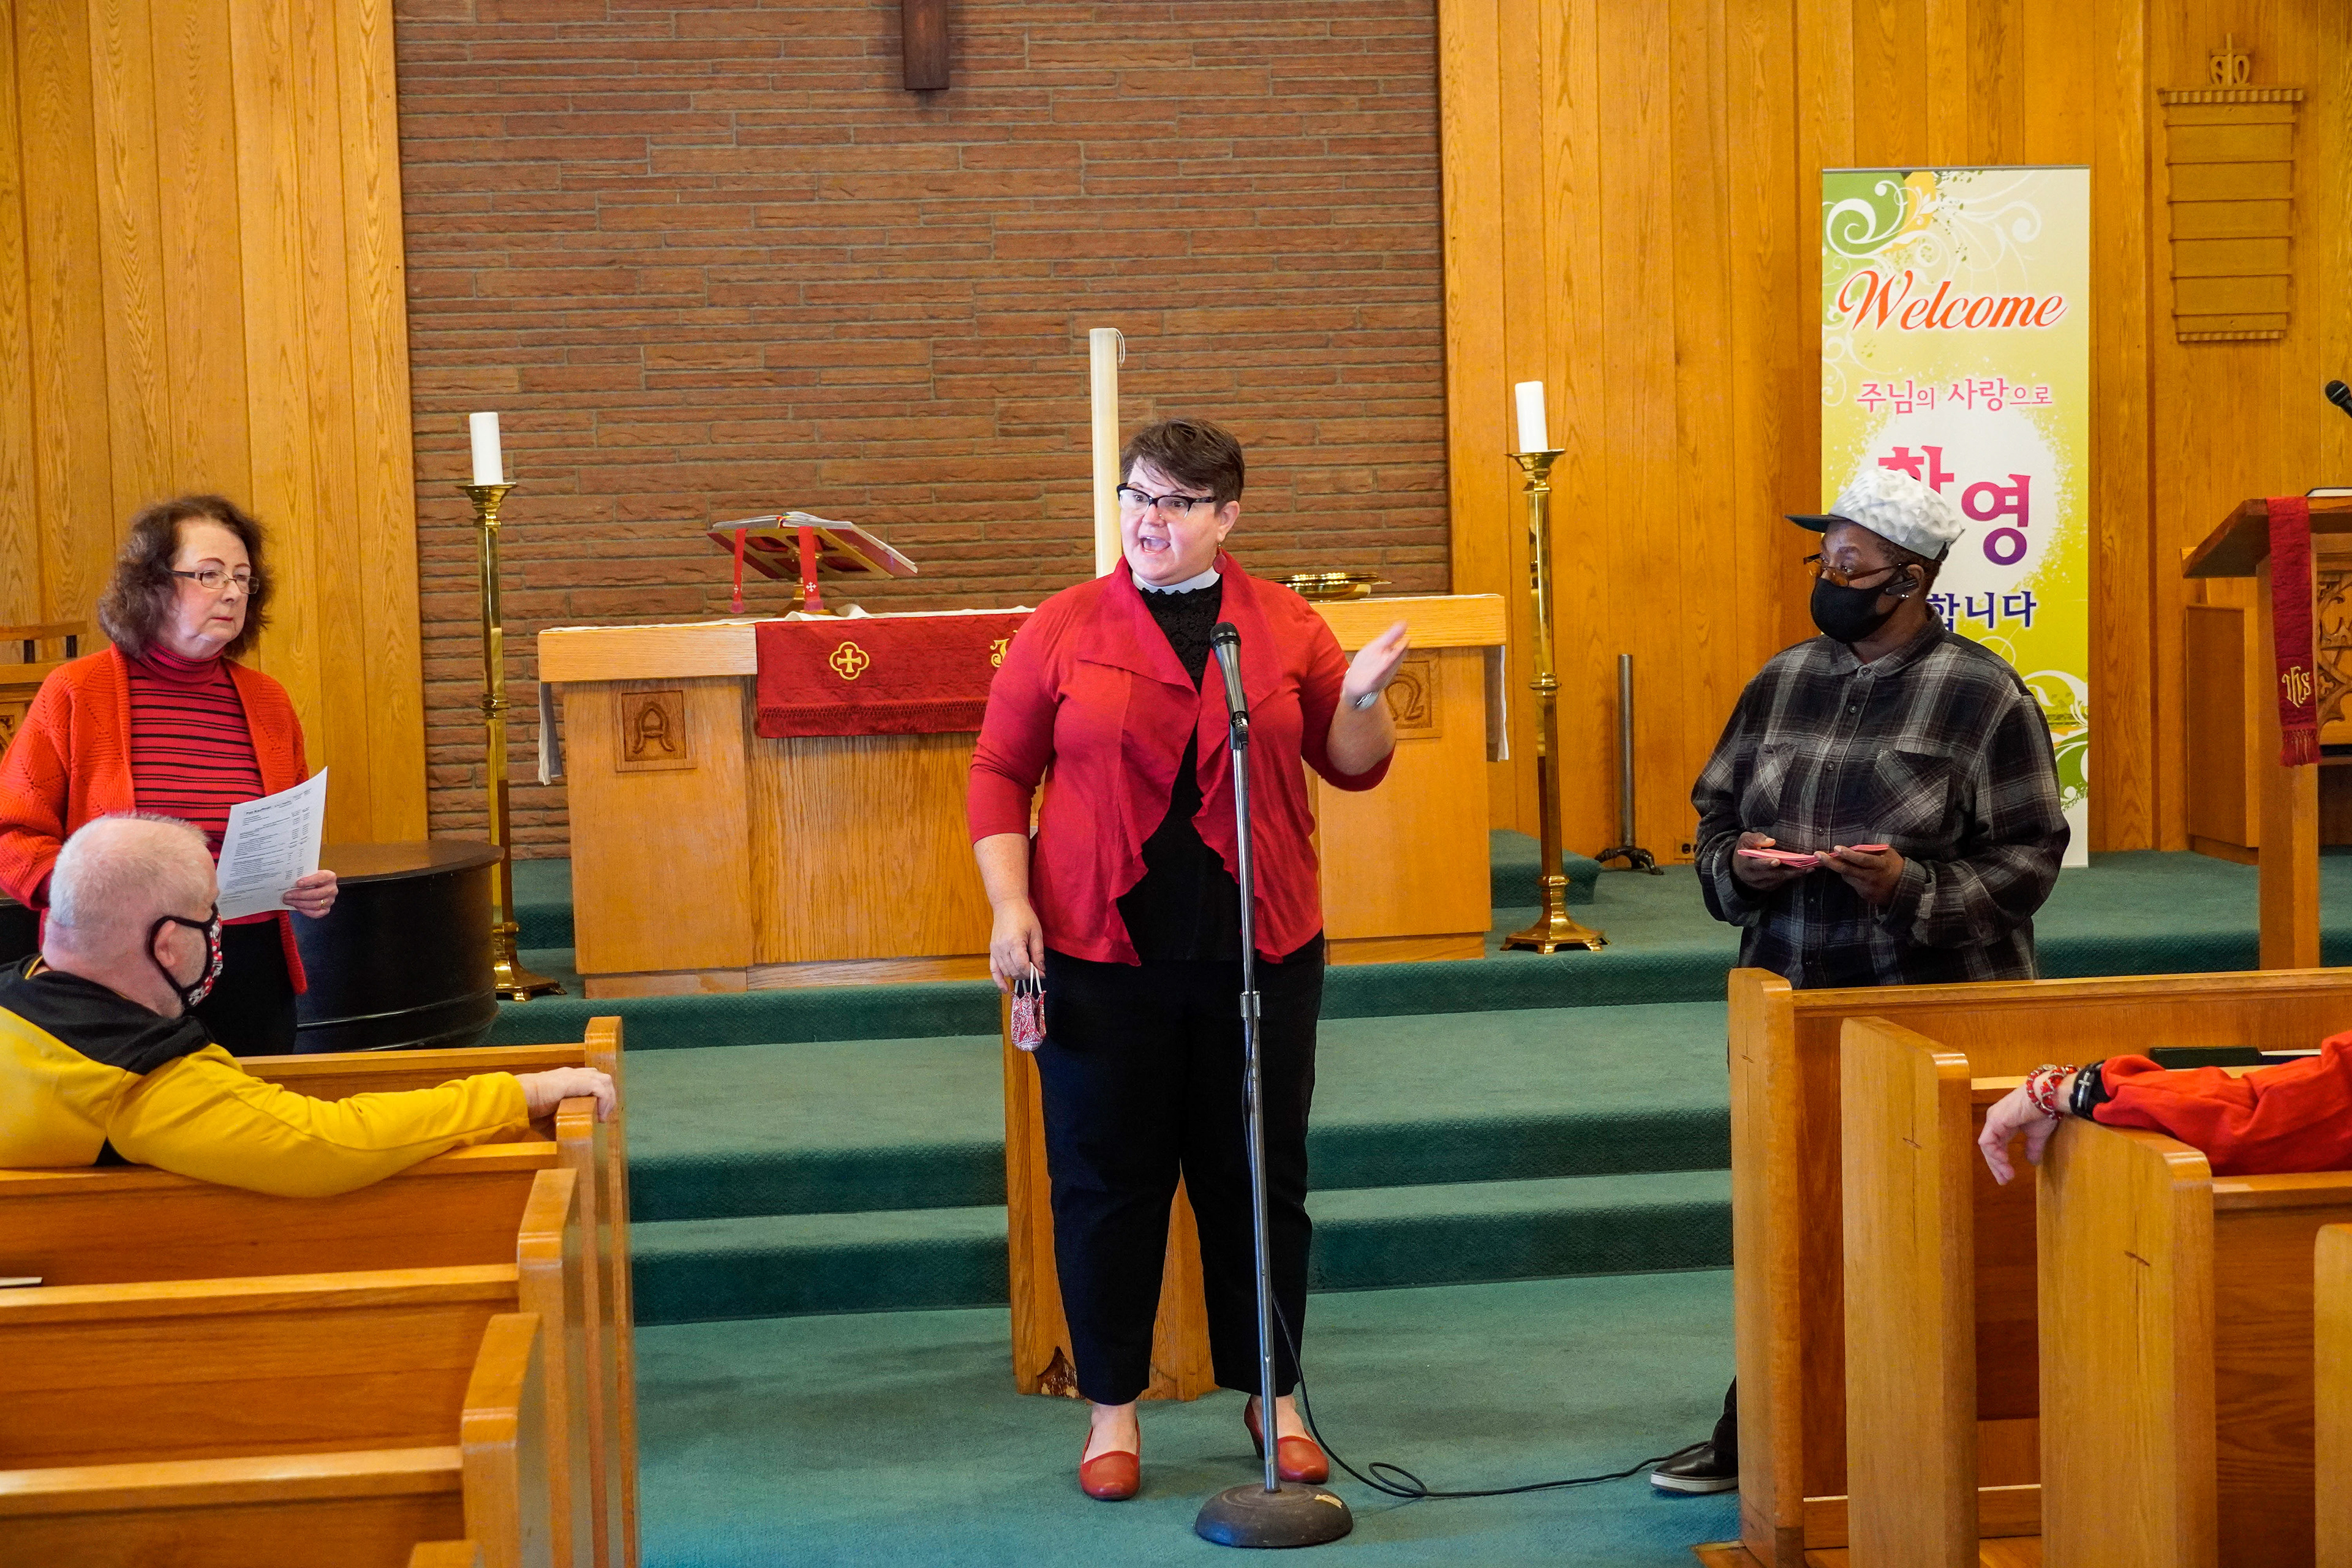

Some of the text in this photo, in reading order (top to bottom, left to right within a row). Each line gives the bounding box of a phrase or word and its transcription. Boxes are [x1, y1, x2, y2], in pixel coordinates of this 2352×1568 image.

[1838, 270, 2068, 331] Welcome
[1856, 377, 2052, 415] 주님의 사랑으로
